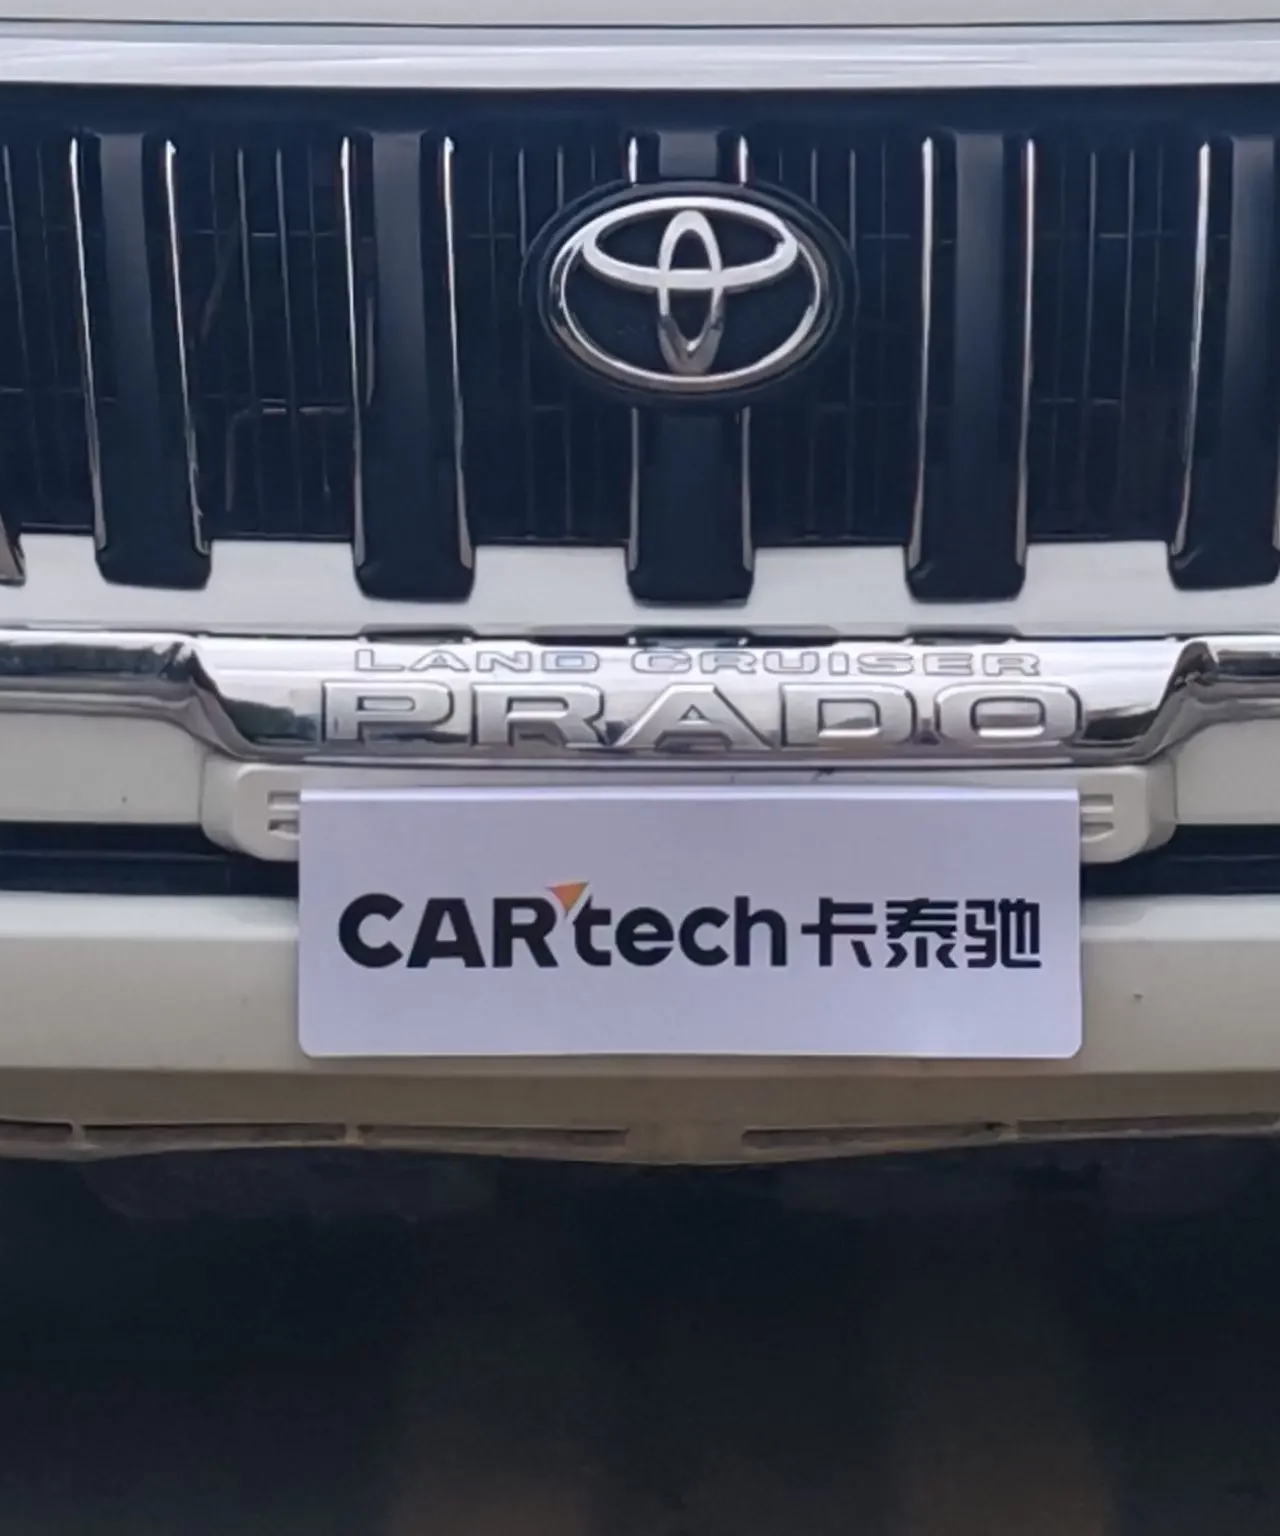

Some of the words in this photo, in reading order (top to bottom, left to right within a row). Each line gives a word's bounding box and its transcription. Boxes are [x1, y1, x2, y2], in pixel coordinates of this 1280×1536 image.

[354, 648, 601, 674] LAND
[631, 651, 1042, 676] CRUISER
[321, 681, 1083, 750] PRADO
[337, 890, 787, 969] CARtech
[801, 897, 1042, 970] 卡泰驰
